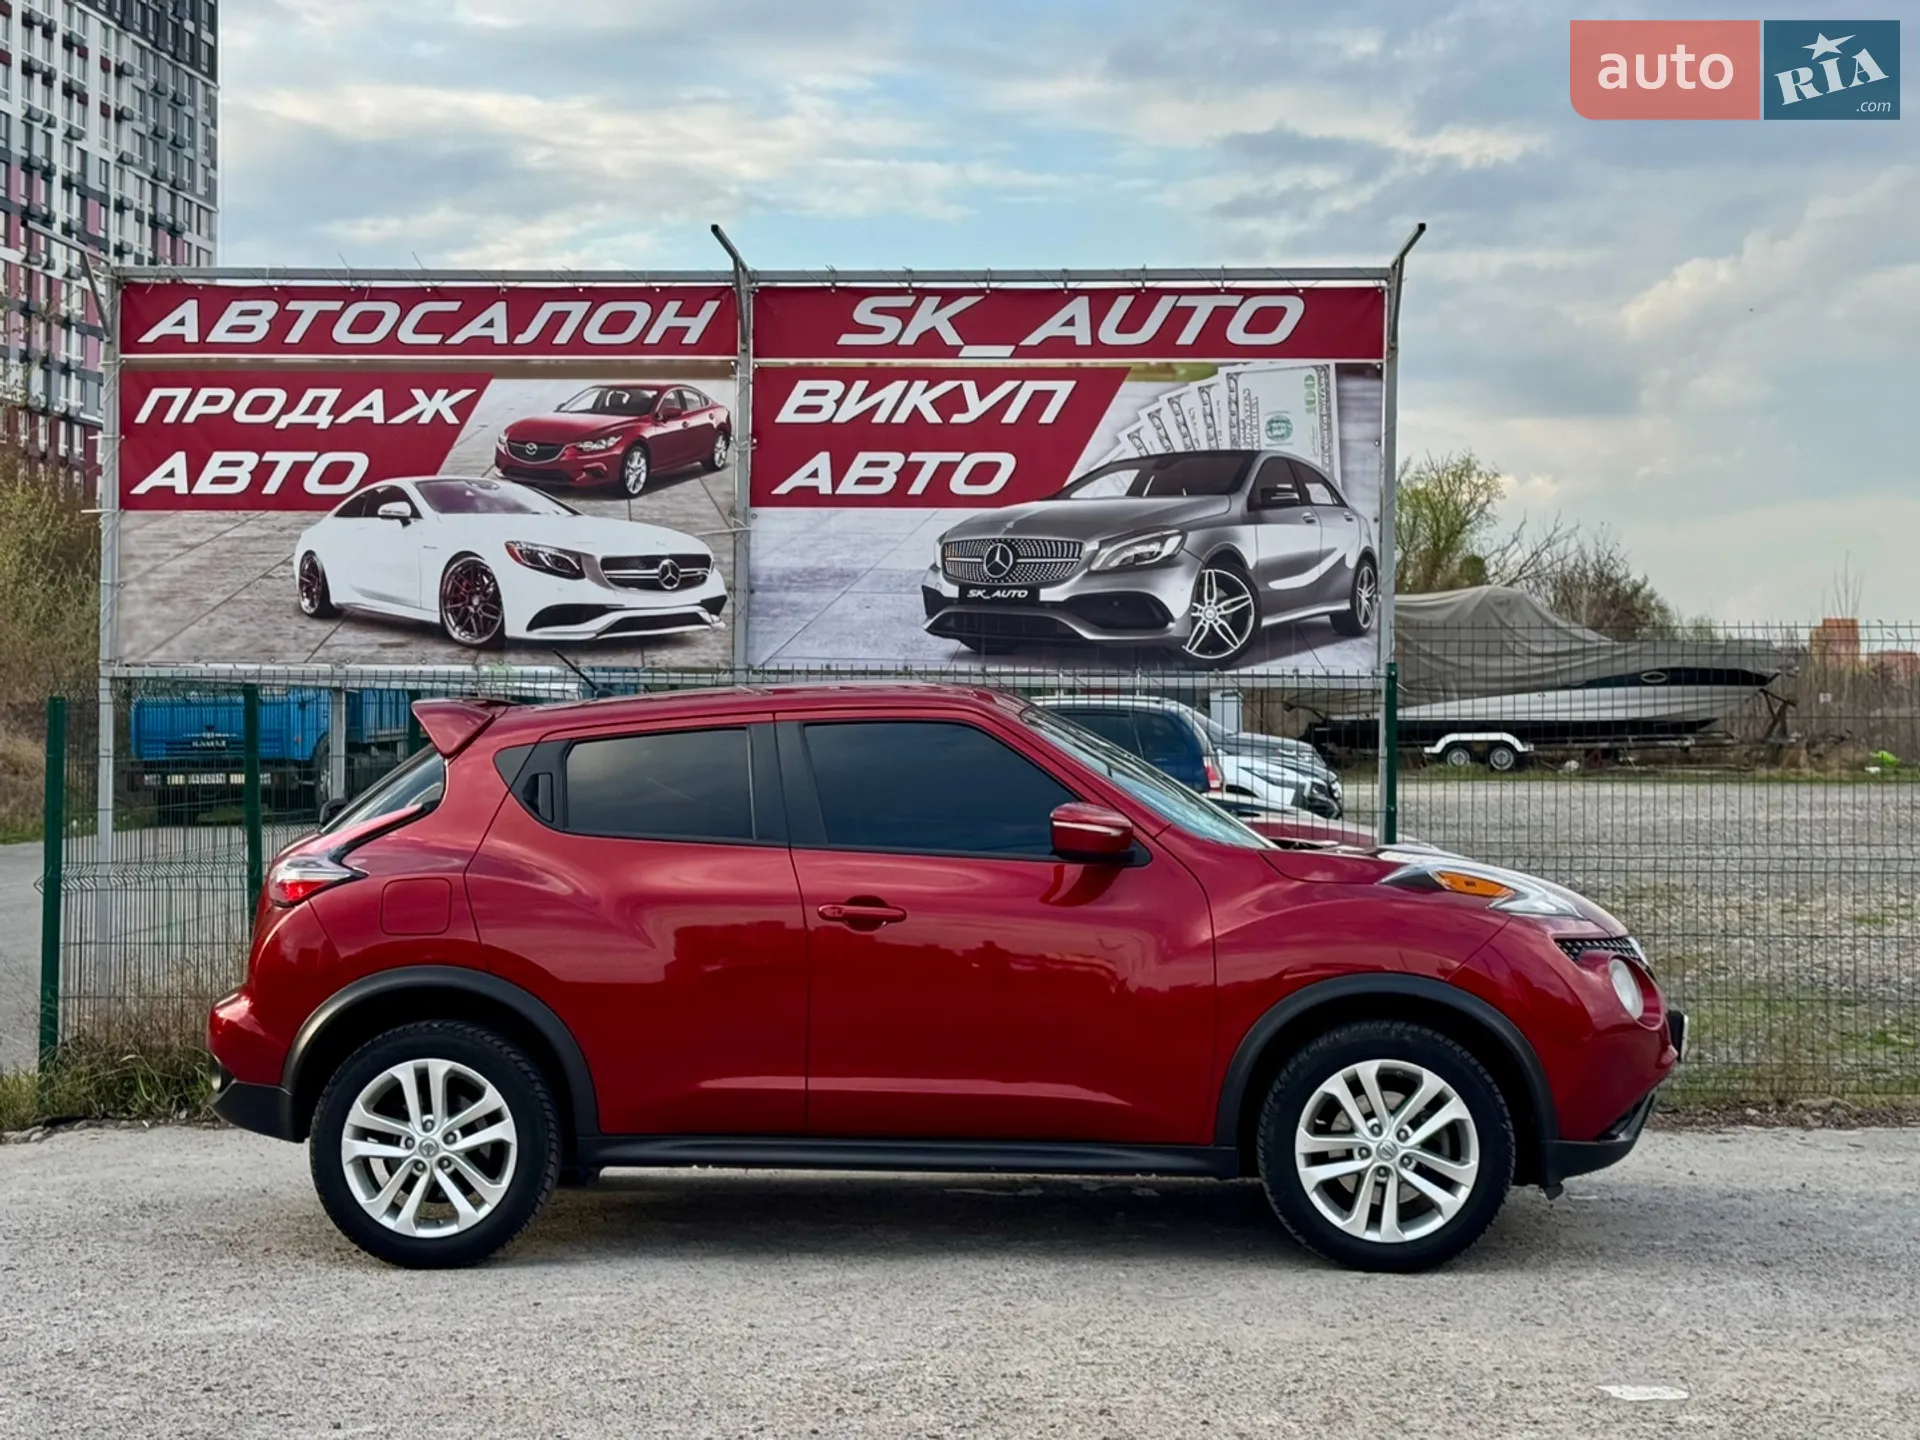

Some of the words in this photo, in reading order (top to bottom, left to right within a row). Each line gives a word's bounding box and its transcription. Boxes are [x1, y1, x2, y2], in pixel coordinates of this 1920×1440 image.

[137, 299, 721, 345] АВТОСАЛОН
[836, 295, 1305, 358] SK_AUTO
[134, 387, 477, 430] ПРОДАЖ
[774, 379, 1077, 424] ВИКУП
[1304, 374, 1317, 416] 100
[129, 450, 370, 496] АВТО
[770, 451, 1017, 496] АВТО
[966, 589, 1029, 599] SK_AUTO
